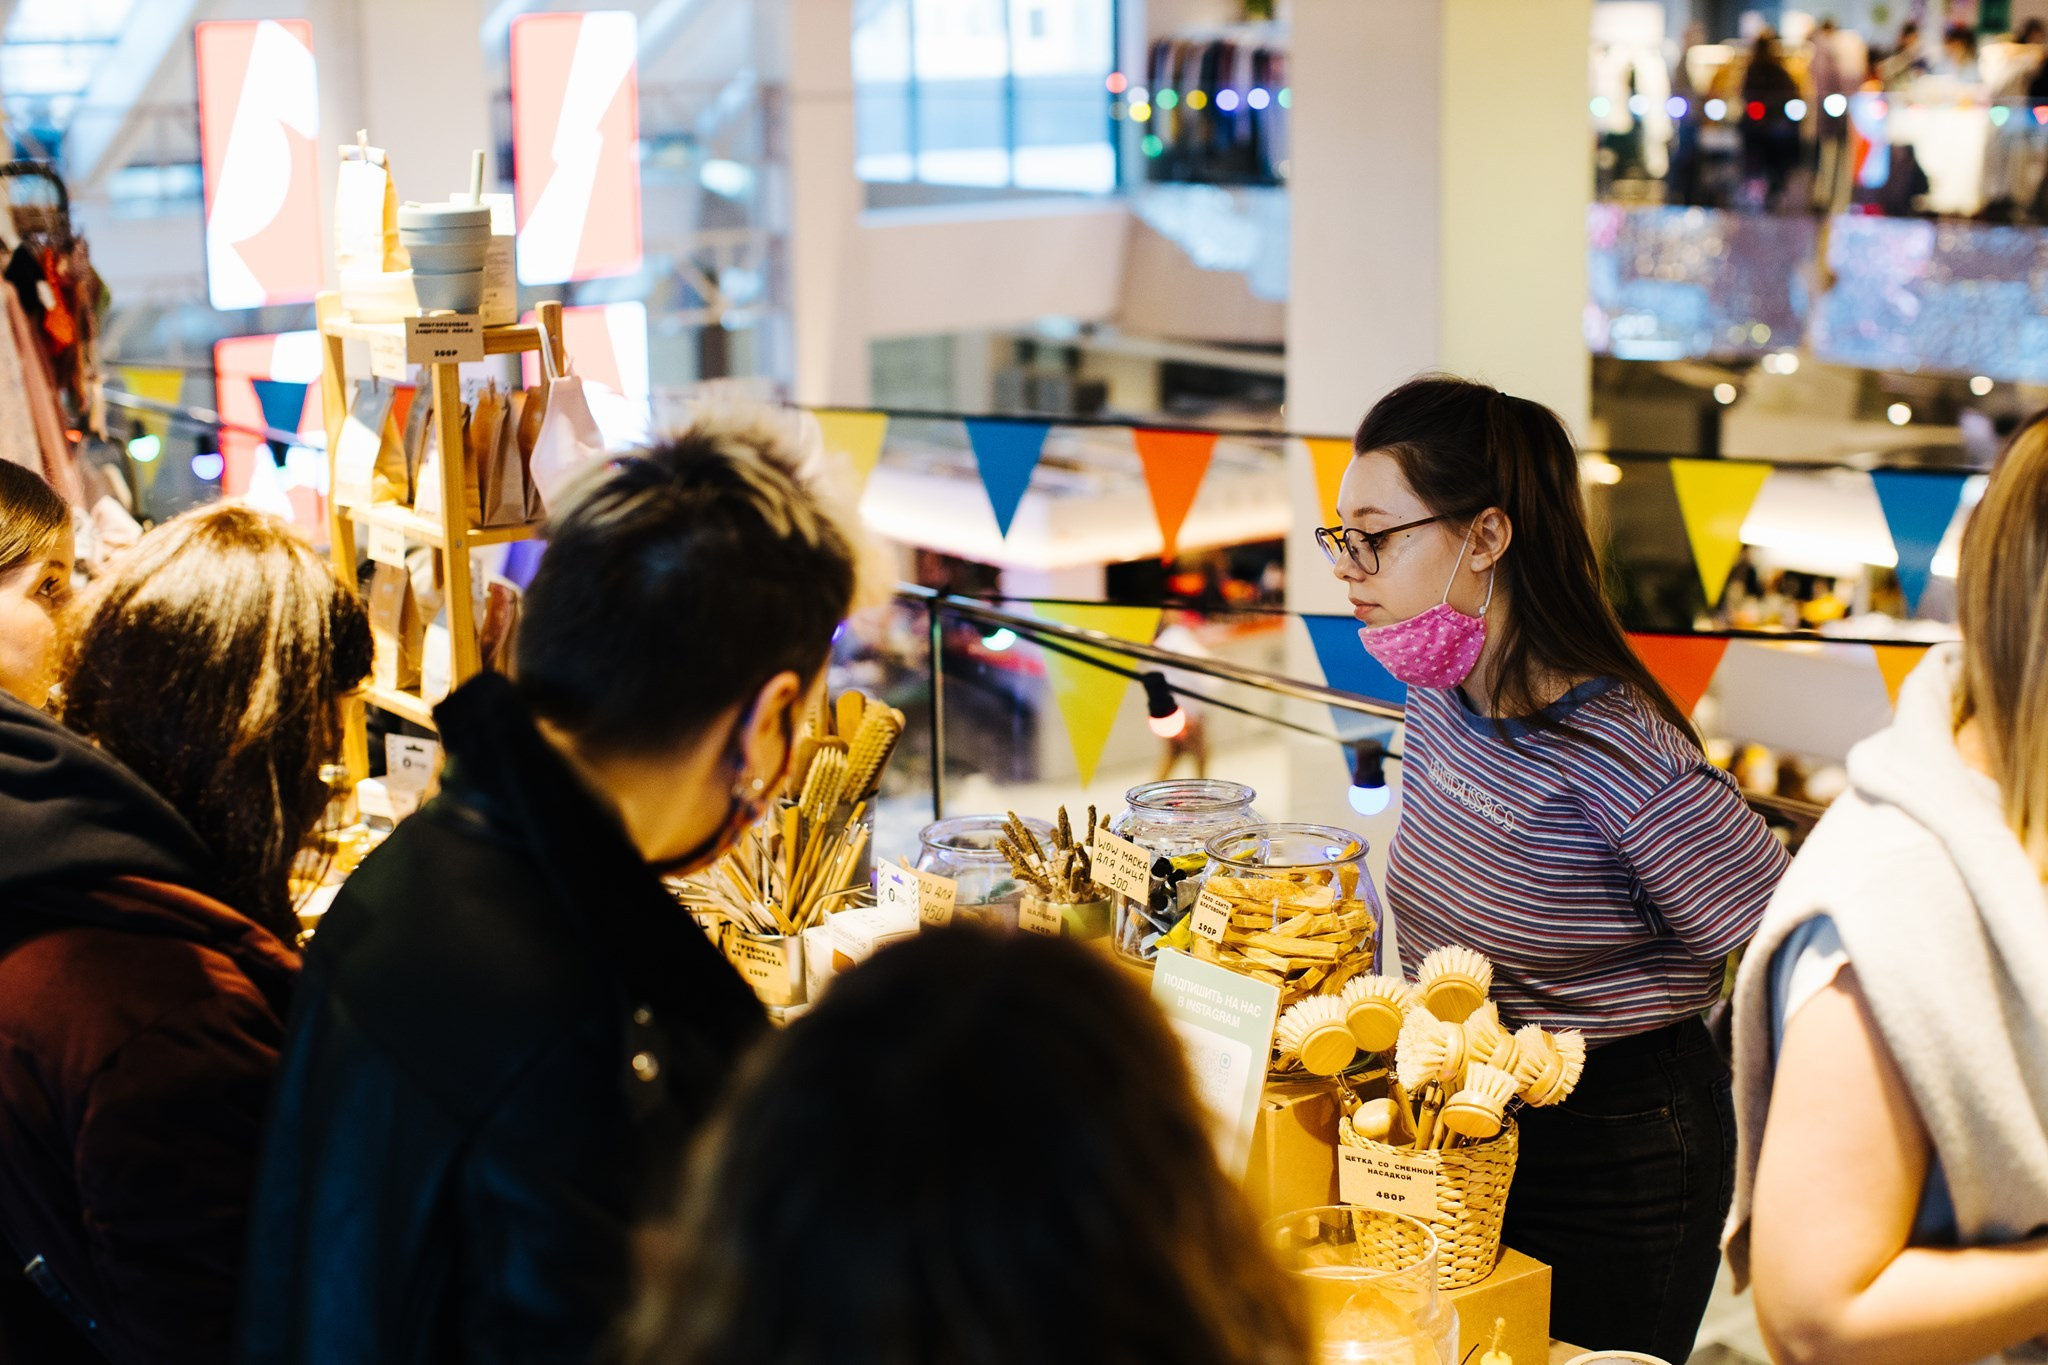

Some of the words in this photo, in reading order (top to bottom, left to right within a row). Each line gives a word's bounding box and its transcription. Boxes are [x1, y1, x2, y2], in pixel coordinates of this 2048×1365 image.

[1098, 837, 1119, 855] WOW
[1122, 850, 1149, 872] МАСКА
[1096, 852, 1115, 869] ДЛЯ
[1119, 864, 1145, 883] ЛИЦА
[924, 902, 946, 921] 450
[1177, 995, 1185, 1007] В
[1186, 998, 1241, 1028] INSTAGRAM
[1224, 994, 1239, 1011] НА
[1240, 1000, 1262, 1018] НАС
[1345, 1155, 1373, 1165] ЩЕТКА
[1394, 1164, 1434, 1175] СМЕННОЙ
[1367, 1168, 1412, 1181] НАСАДКОЙ
